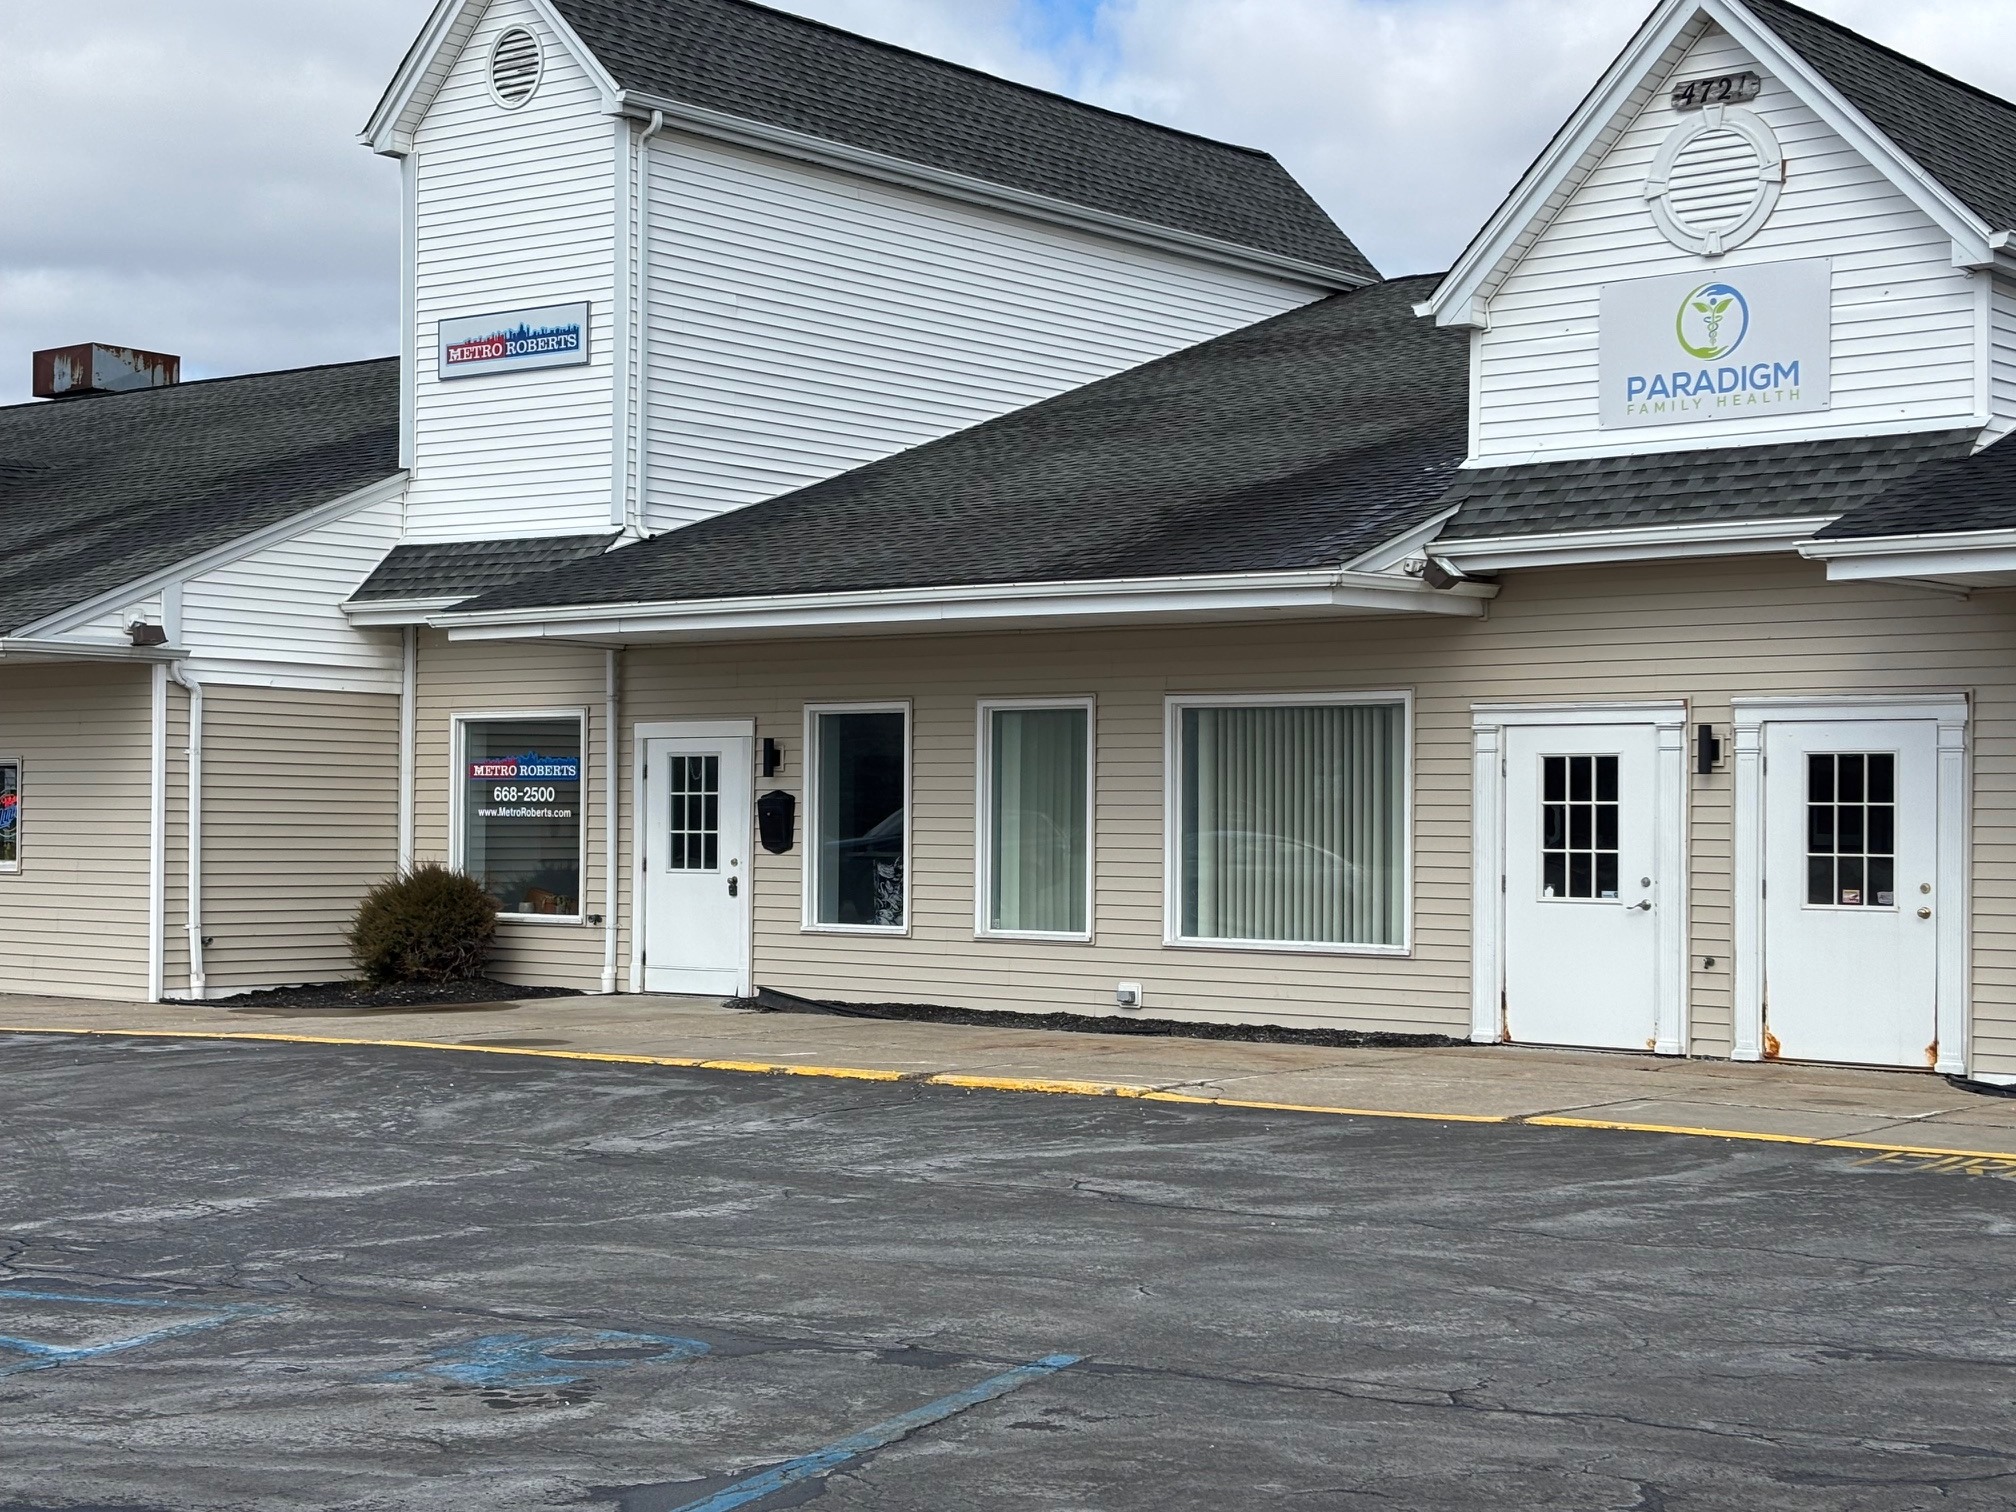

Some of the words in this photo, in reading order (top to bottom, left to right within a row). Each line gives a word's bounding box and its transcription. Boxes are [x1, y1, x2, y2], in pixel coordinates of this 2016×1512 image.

[1681, 75, 1747, 105] 4721
[449, 343, 503, 362] METRO
[505, 334, 577, 355] ROBERTS
[1627, 361, 1800, 402] PARADIGM
[1626, 398, 1702, 416] FAMILY
[1716, 389, 1801, 408] HEALTH
[473, 765, 517, 776] METRO
[519, 764, 576, 776] ROBERTS
[493, 787, 555, 802] 668-2500
[478, 807, 571, 818] www.MetroRoberts.com
[1850, 1151, 2016, 1178] FIR
